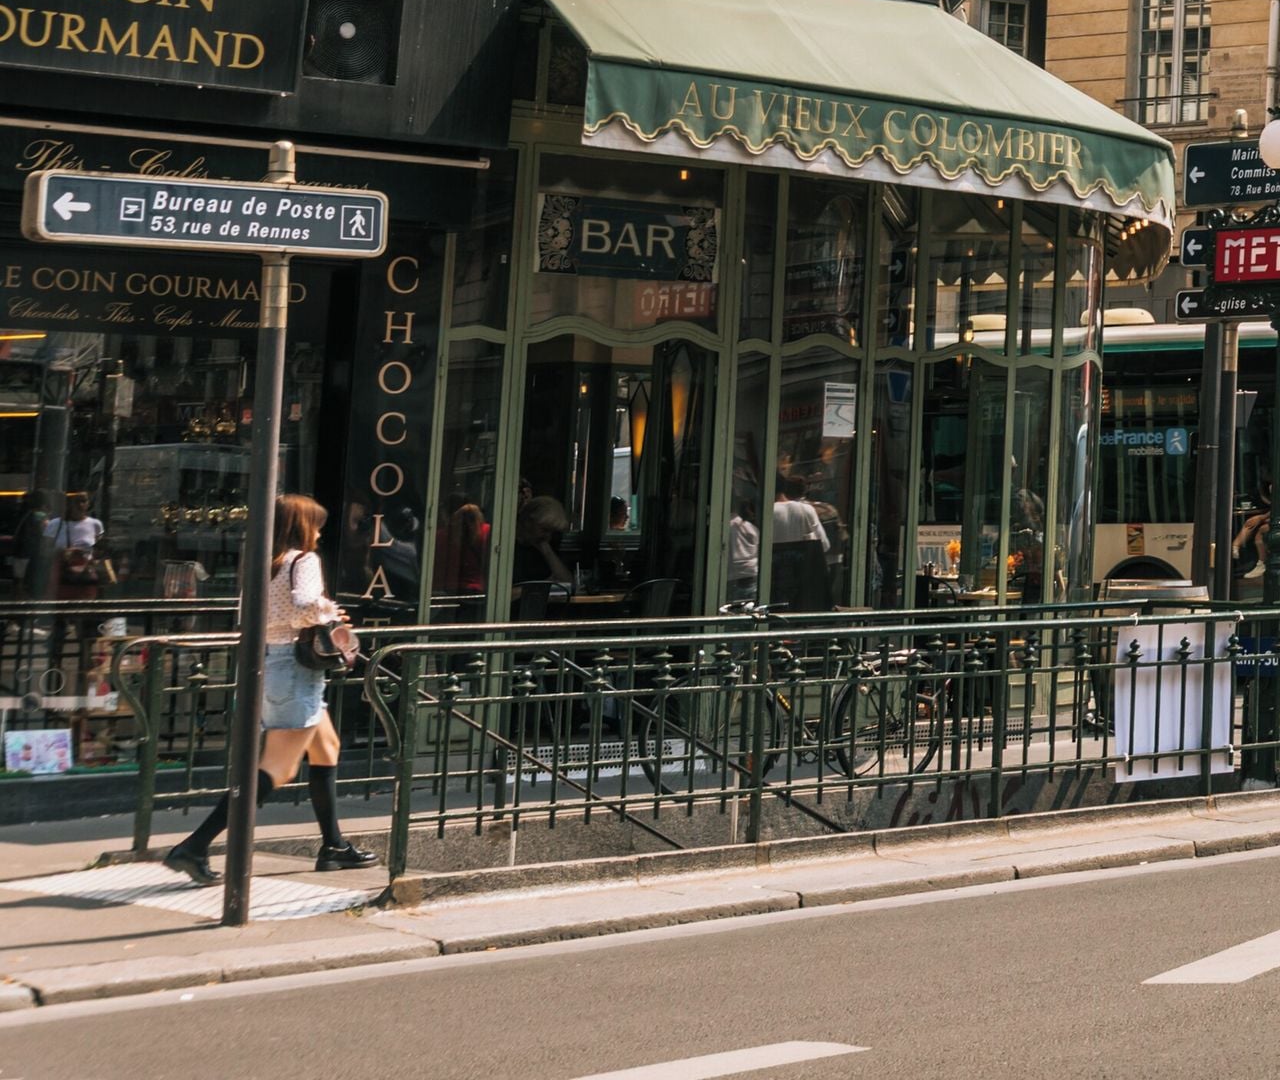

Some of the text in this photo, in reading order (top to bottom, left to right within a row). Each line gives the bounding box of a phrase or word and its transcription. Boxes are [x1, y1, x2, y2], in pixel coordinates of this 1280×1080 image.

[676, 81, 1084, 170] AU VIEUX COLOMBIER
[15, 139, 85, 171] Thés
[152, 190, 336, 221] Bureau de Poste
[1246, 184, 1262, 194] Rue
[150, 216, 311, 241] 53, rue de Rennes
[580, 219, 677, 259] BAR
[0, 265, 307, 304] E COIN GOURMAD
[8, 296, 80, 320] Chocolats
[98, 301, 136, 323] Thés
[153, 303, 194, 331] Cafés
